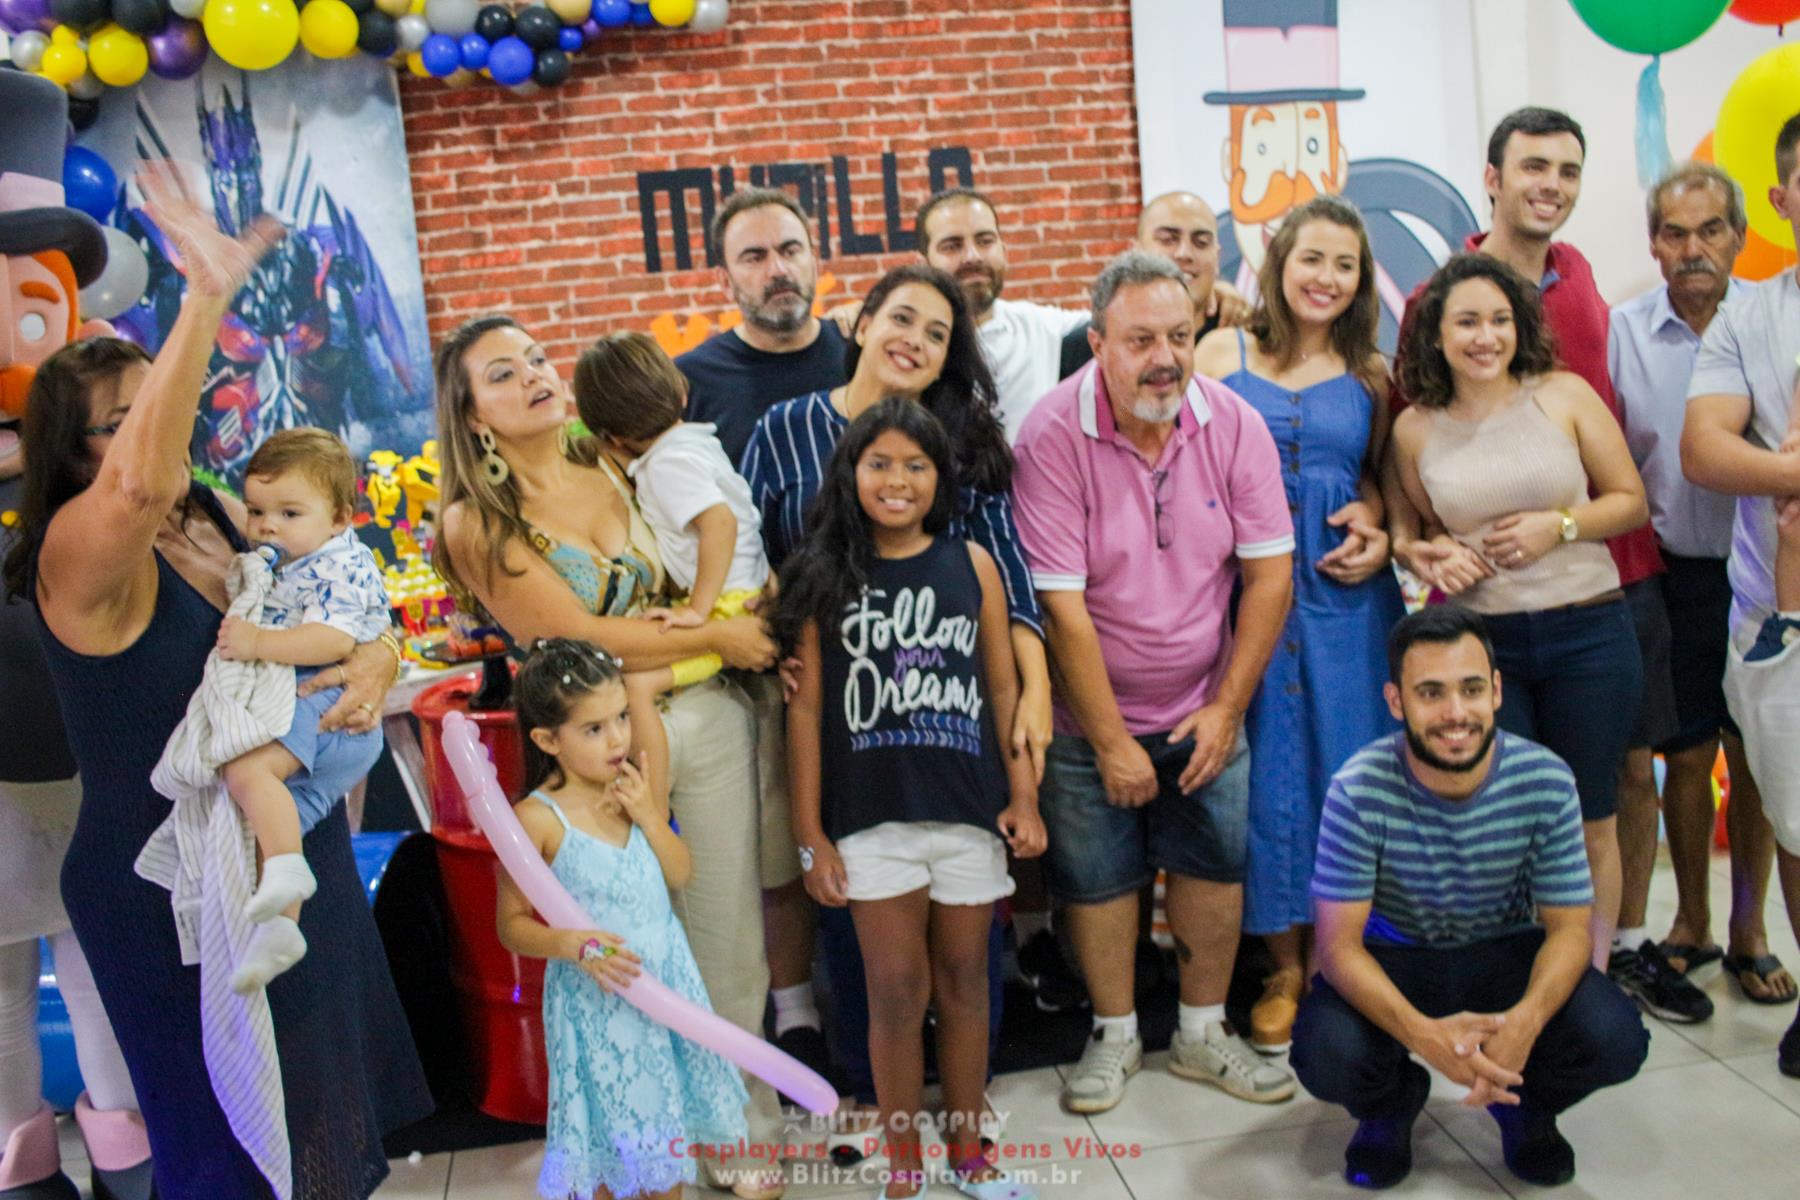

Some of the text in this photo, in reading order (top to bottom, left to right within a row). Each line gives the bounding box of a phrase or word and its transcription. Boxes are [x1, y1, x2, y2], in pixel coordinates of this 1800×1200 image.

[841, 584, 979, 658] Follow
[844, 656, 983, 733] Dreams
[894, 647, 946, 686] your
